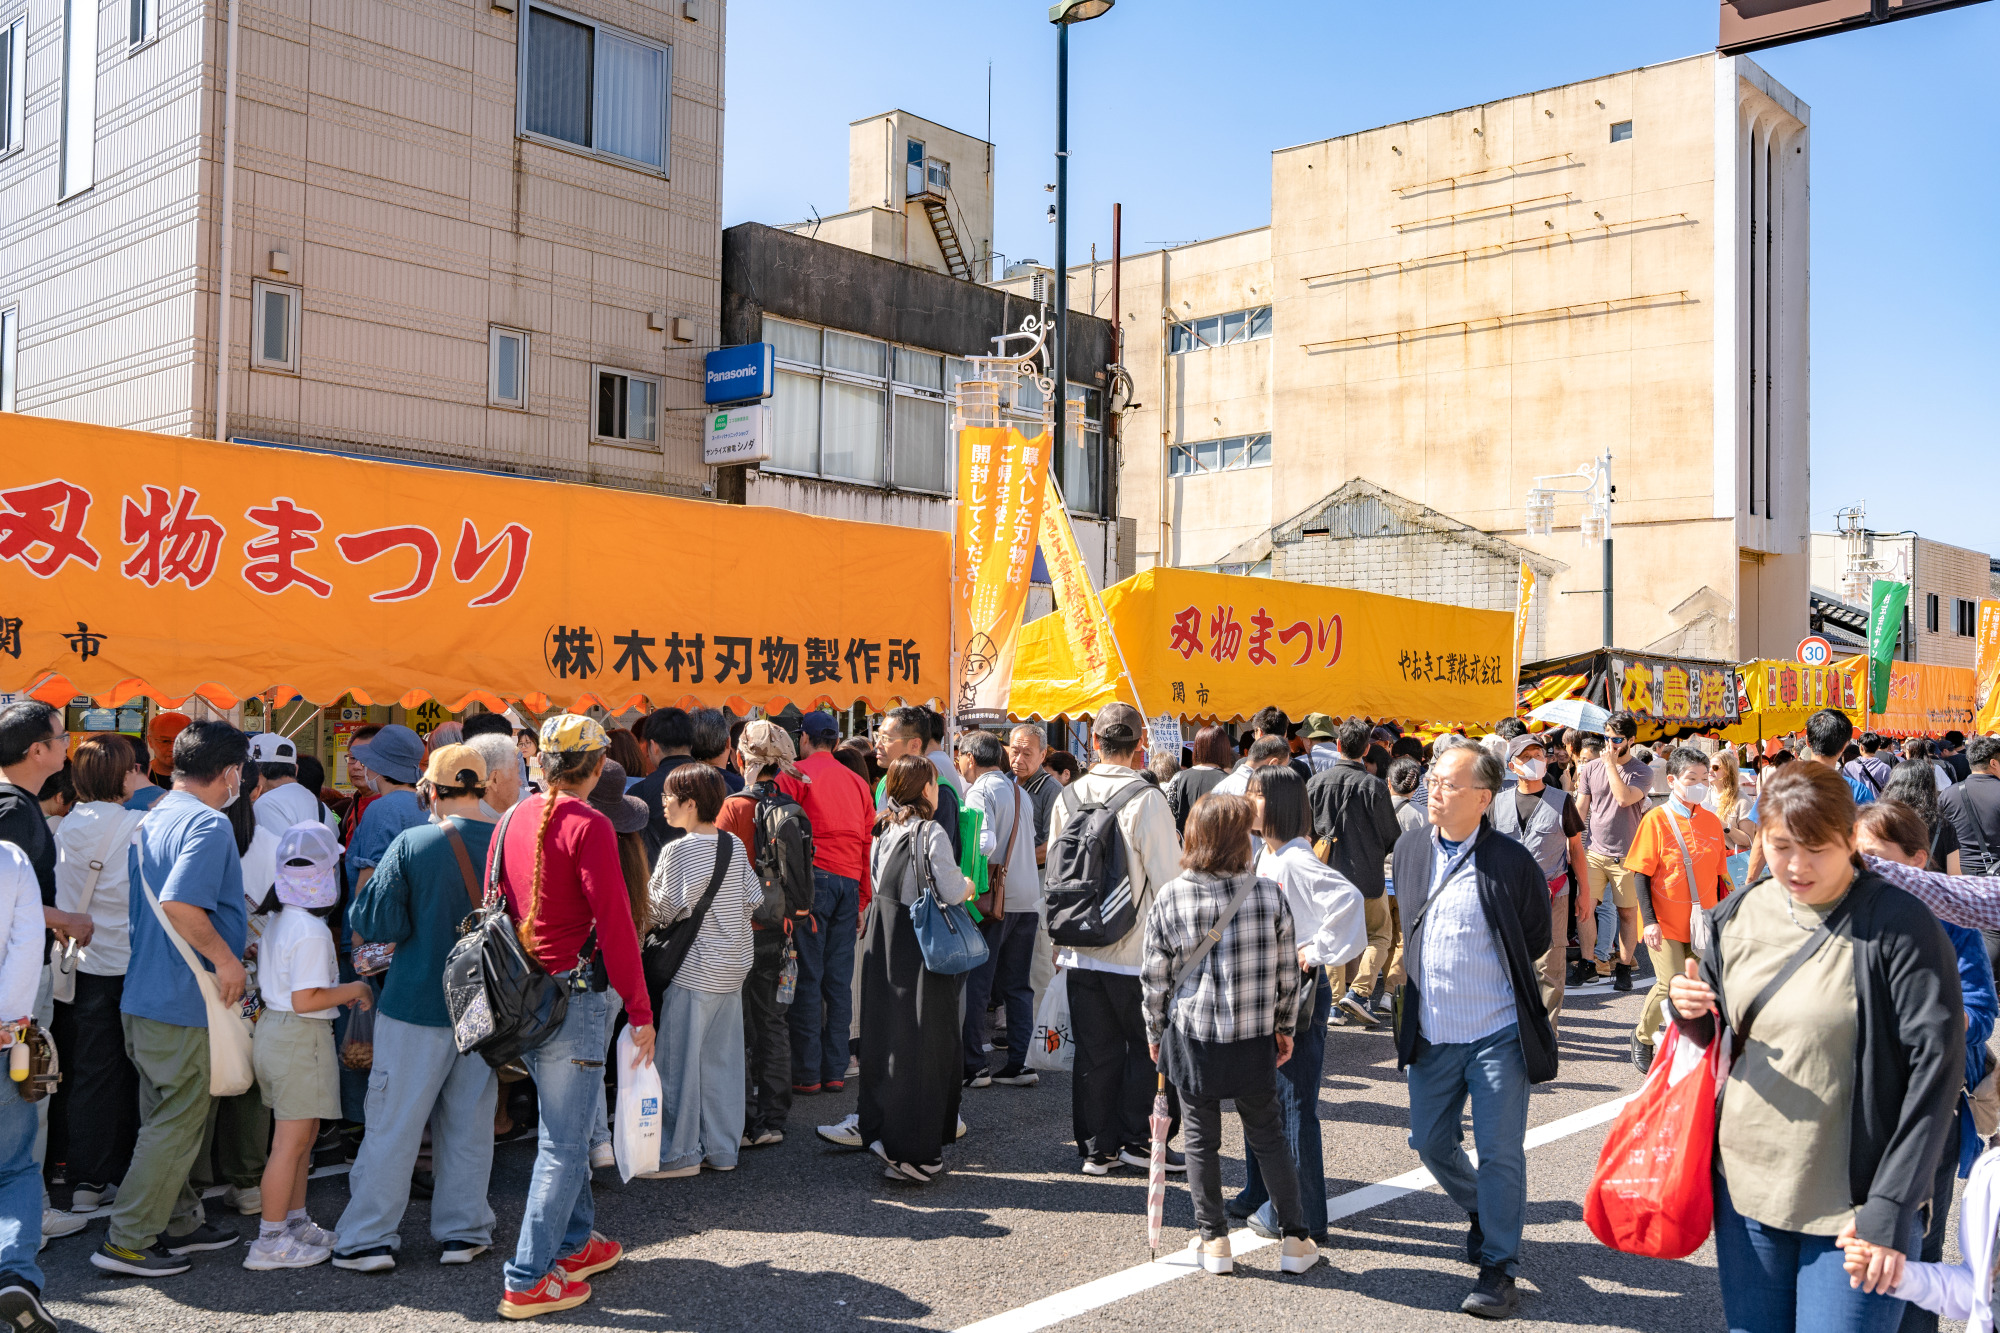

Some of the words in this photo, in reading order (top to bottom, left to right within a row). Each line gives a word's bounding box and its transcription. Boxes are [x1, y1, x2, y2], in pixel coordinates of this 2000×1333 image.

[707, 363, 757, 384] Panasonic
[737, 438, 755, 452] シノダ
[993, 444, 1016, 543] ご帰宅後に
[962, 443, 992, 600] 開封してください
[1805, 646, 1824, 661] 30
[1398, 649, 1503, 685] やおき工業株式会社
[1171, 681, 1210, 707] 関市
[1889, 669, 1920, 700] まつり
[416, 702, 441, 718] 4K
